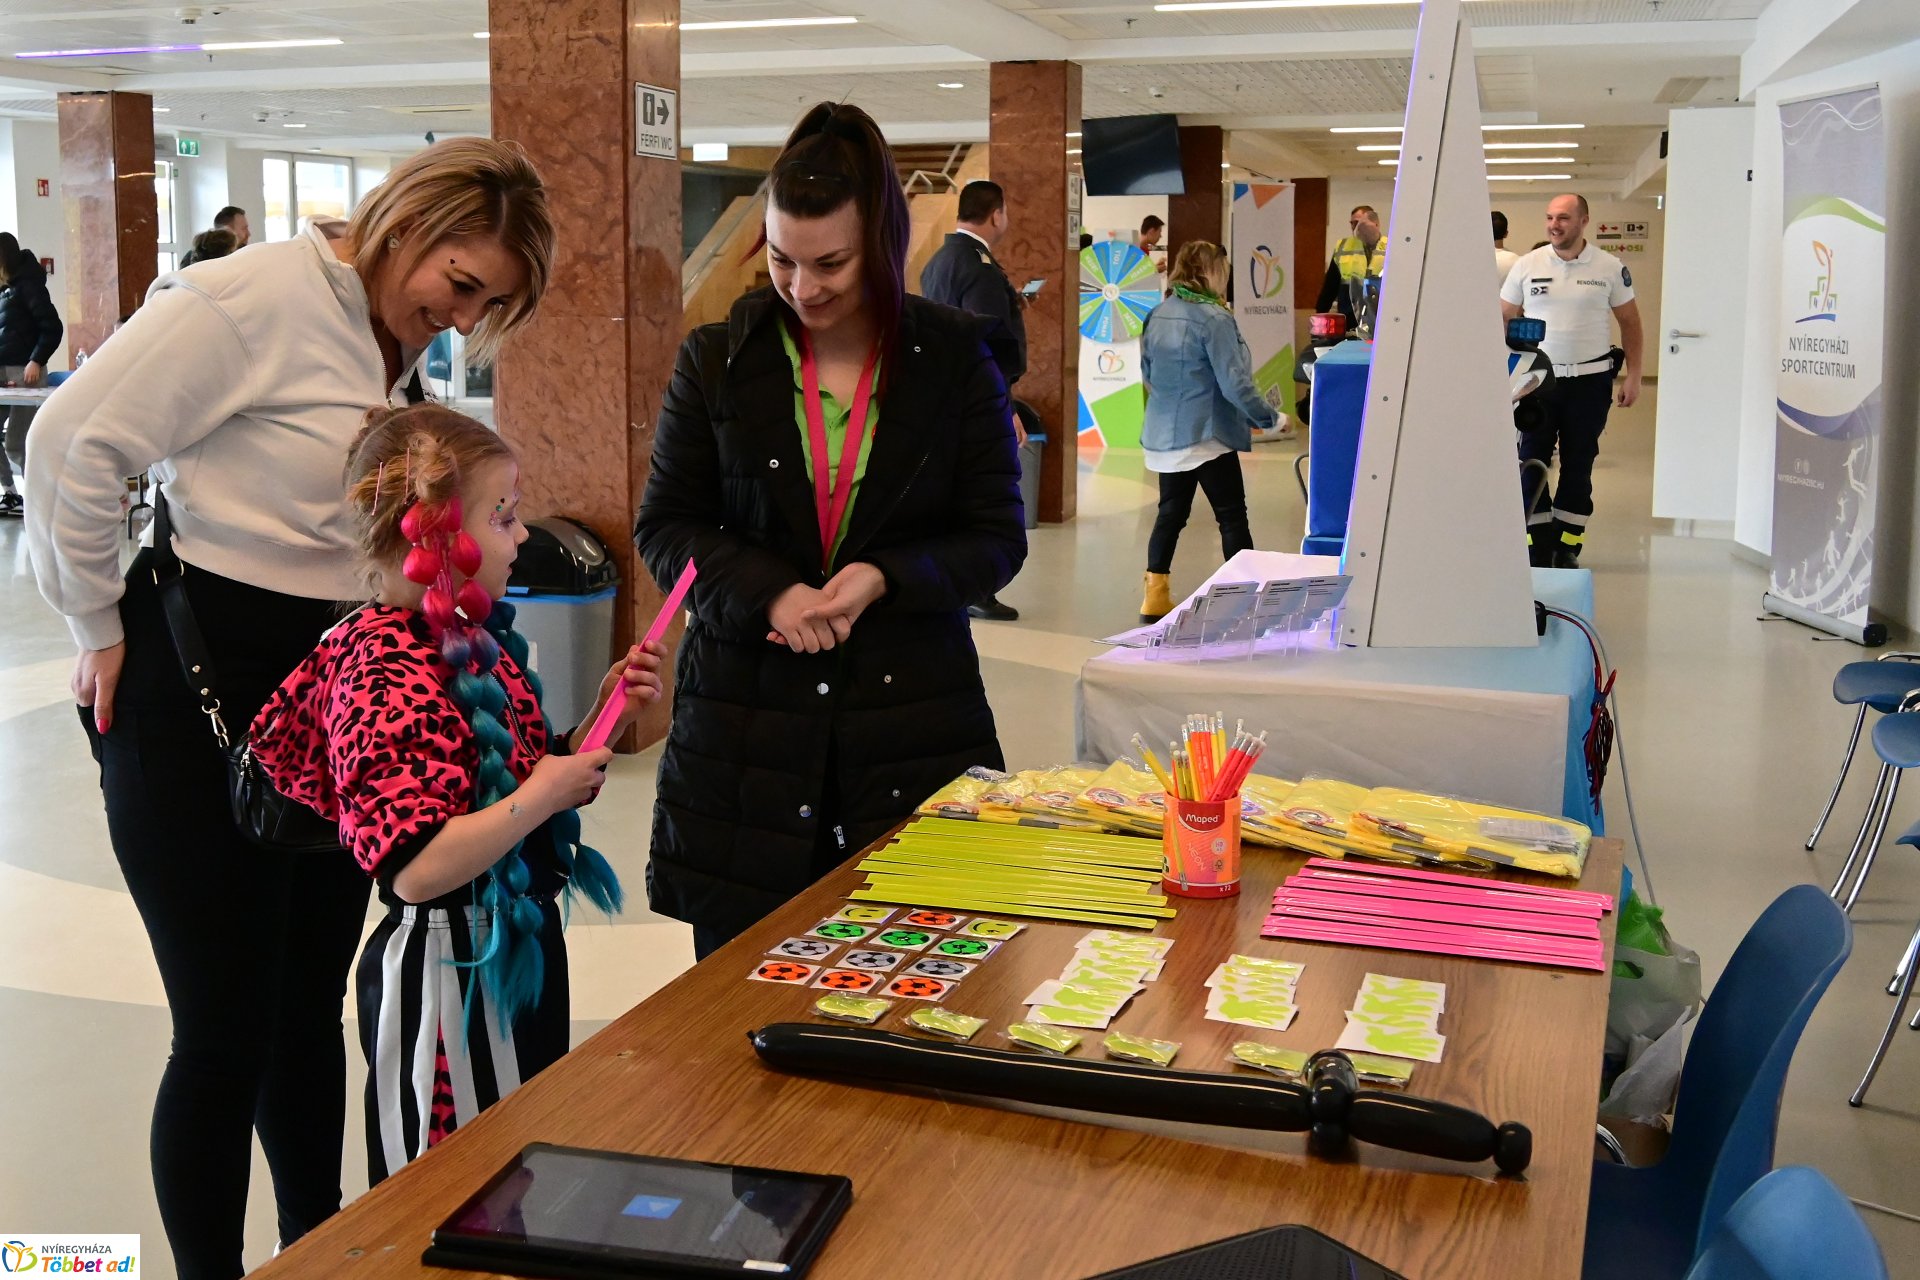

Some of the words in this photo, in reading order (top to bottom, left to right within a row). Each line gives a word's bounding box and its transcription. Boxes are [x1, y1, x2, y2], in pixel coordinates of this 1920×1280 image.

[641, 132, 659, 148] FÉRFI
[660, 137, 673, 150] WC
[1789, 334, 1849, 355] NYÍREGYHÁZI
[1781, 358, 1856, 379] SPORTCENTRUM
[1185, 813, 1219, 824] Maped
[1187, 842, 1207, 872] NEON
